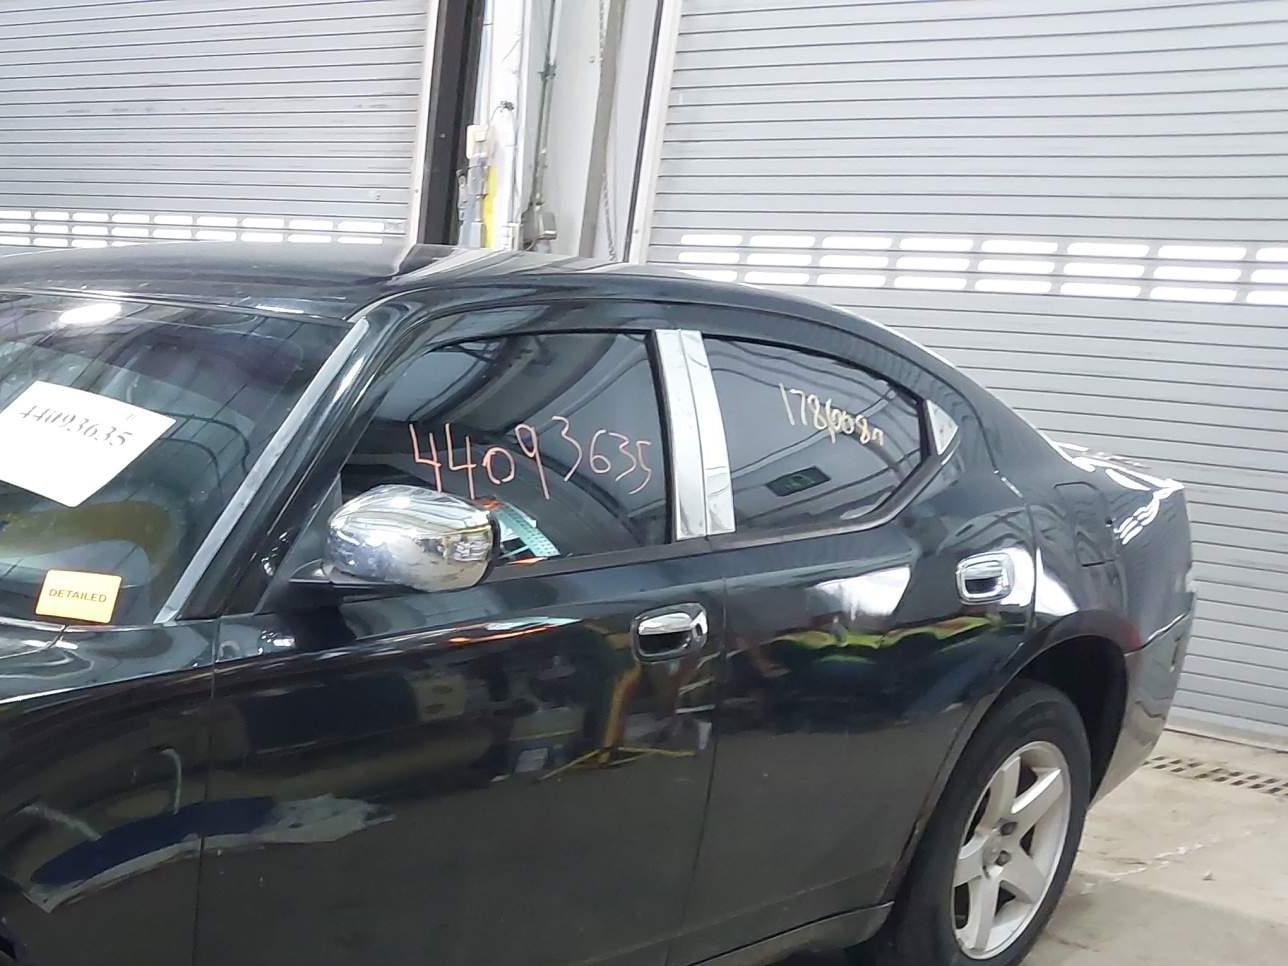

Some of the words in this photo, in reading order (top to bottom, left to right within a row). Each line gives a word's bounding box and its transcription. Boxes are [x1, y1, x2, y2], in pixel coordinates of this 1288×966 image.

[19, 405, 133, 447] 44093635
[409, 415, 652, 500] 44093635
[48, 588, 108, 603] DETAILED
